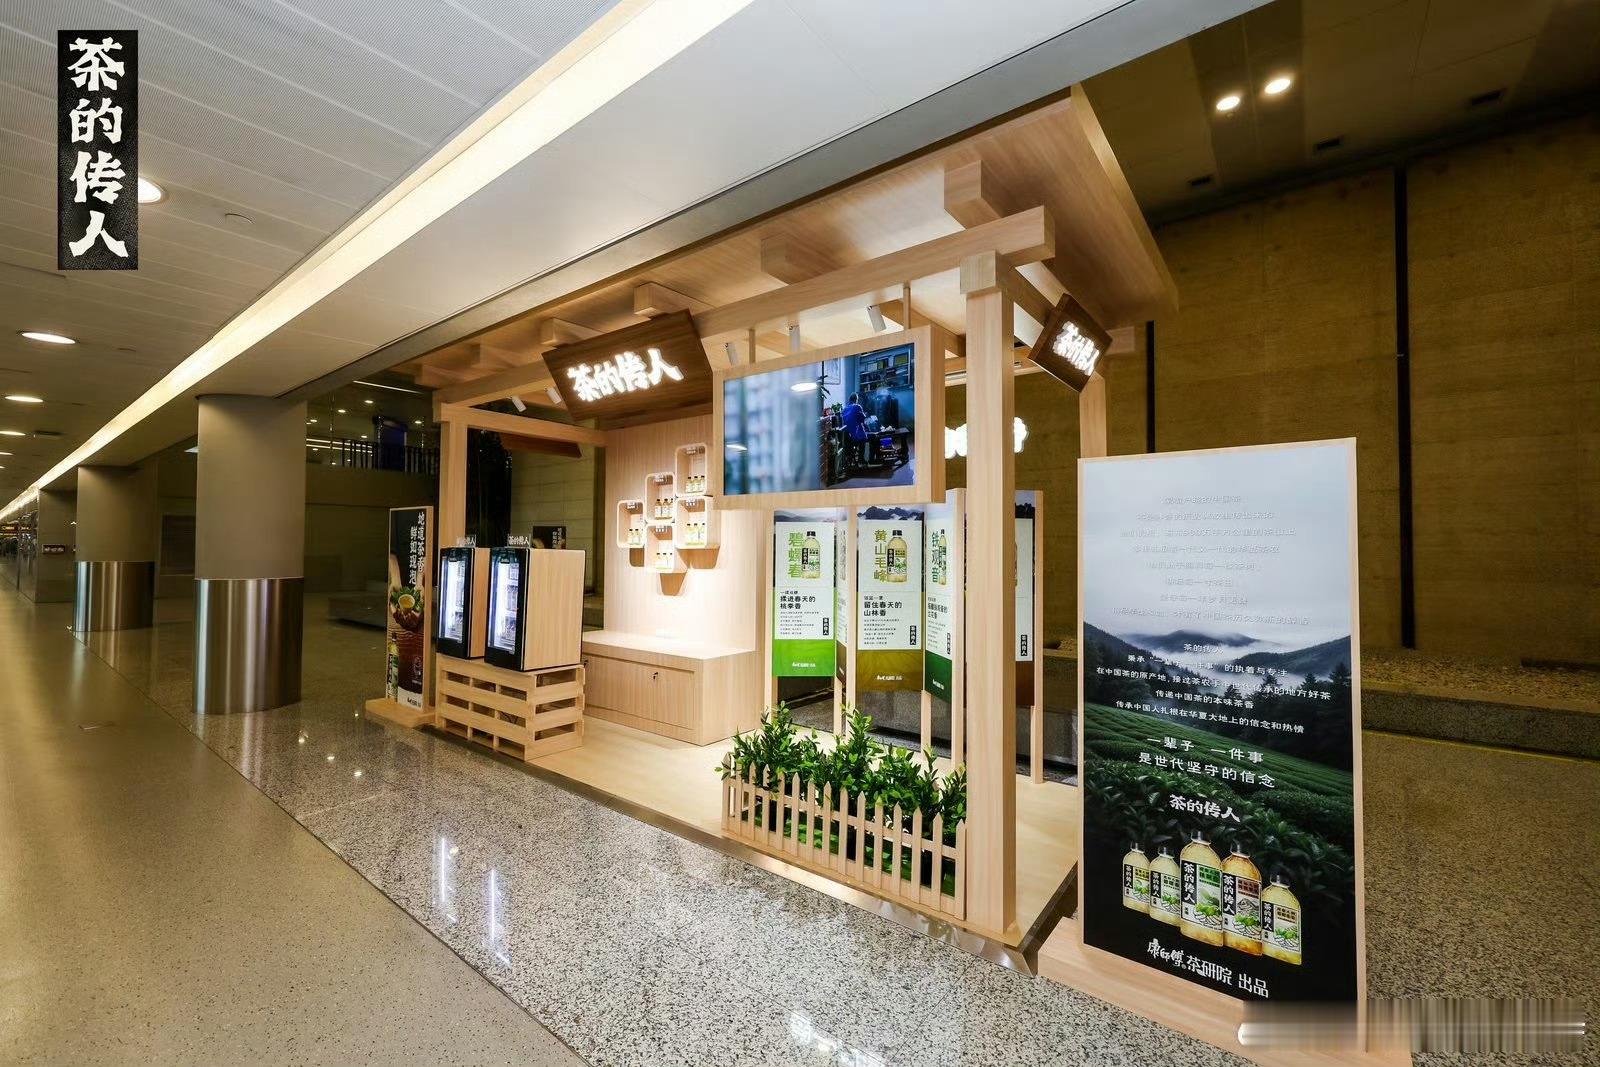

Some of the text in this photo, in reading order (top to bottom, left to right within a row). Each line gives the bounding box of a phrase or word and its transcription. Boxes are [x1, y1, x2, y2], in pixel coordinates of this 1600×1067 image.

[566, 347, 685, 402] 茶的传人
[417, 511, 425, 573] 地道茶香
[874, 529, 887, 582] 黄山毛峰
[931, 531, 940, 583] 铁观音
[1115, 700, 1304, 734] 传承中国人扎根在华夏大地上的信念和热情
[1155, 689, 1254, 709] 传递中国茶的本味茶香
[1147, 736, 1264, 764] 一辈子 一件事
[1138, 752, 1275, 788] 是世代坚守的信念
[1169, 794, 1240, 822] 茶的传人
[1184, 862, 1196, 904] 茶的传人
[1223, 875, 1235, 915] 茶的传人
[1238, 973, 1268, 998] 出品
